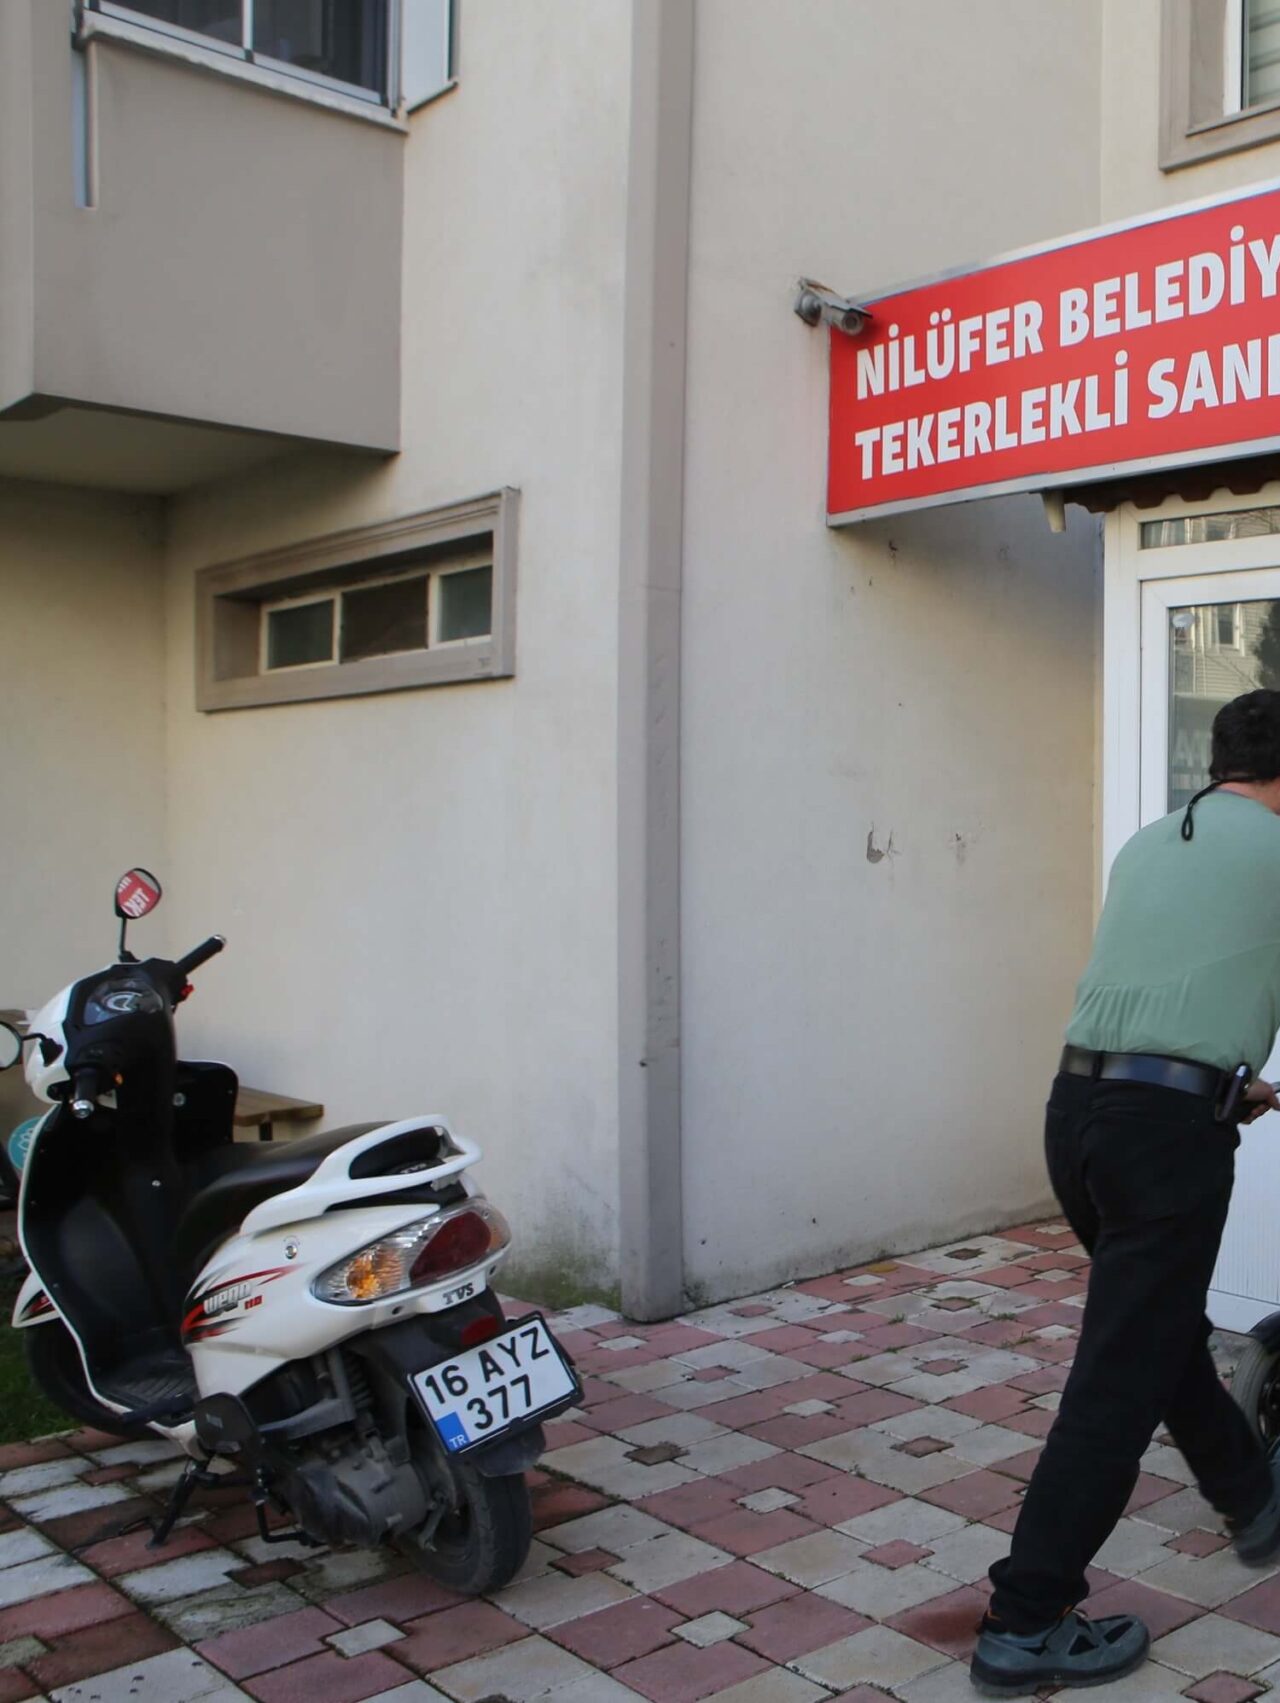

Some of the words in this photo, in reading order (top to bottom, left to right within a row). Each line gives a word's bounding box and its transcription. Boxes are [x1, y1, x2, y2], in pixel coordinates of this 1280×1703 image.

[856, 300, 1044, 400] NİLÜFER
[855, 349, 1129, 480] TEKERLEKLİ
[442, 1282, 476, 1305] TVS
[424, 1364, 469, 1405] 16
[477, 1326, 550, 1384] AYZ
[466, 1373, 533, 1431] 377
[449, 1433, 468, 1449] TR
